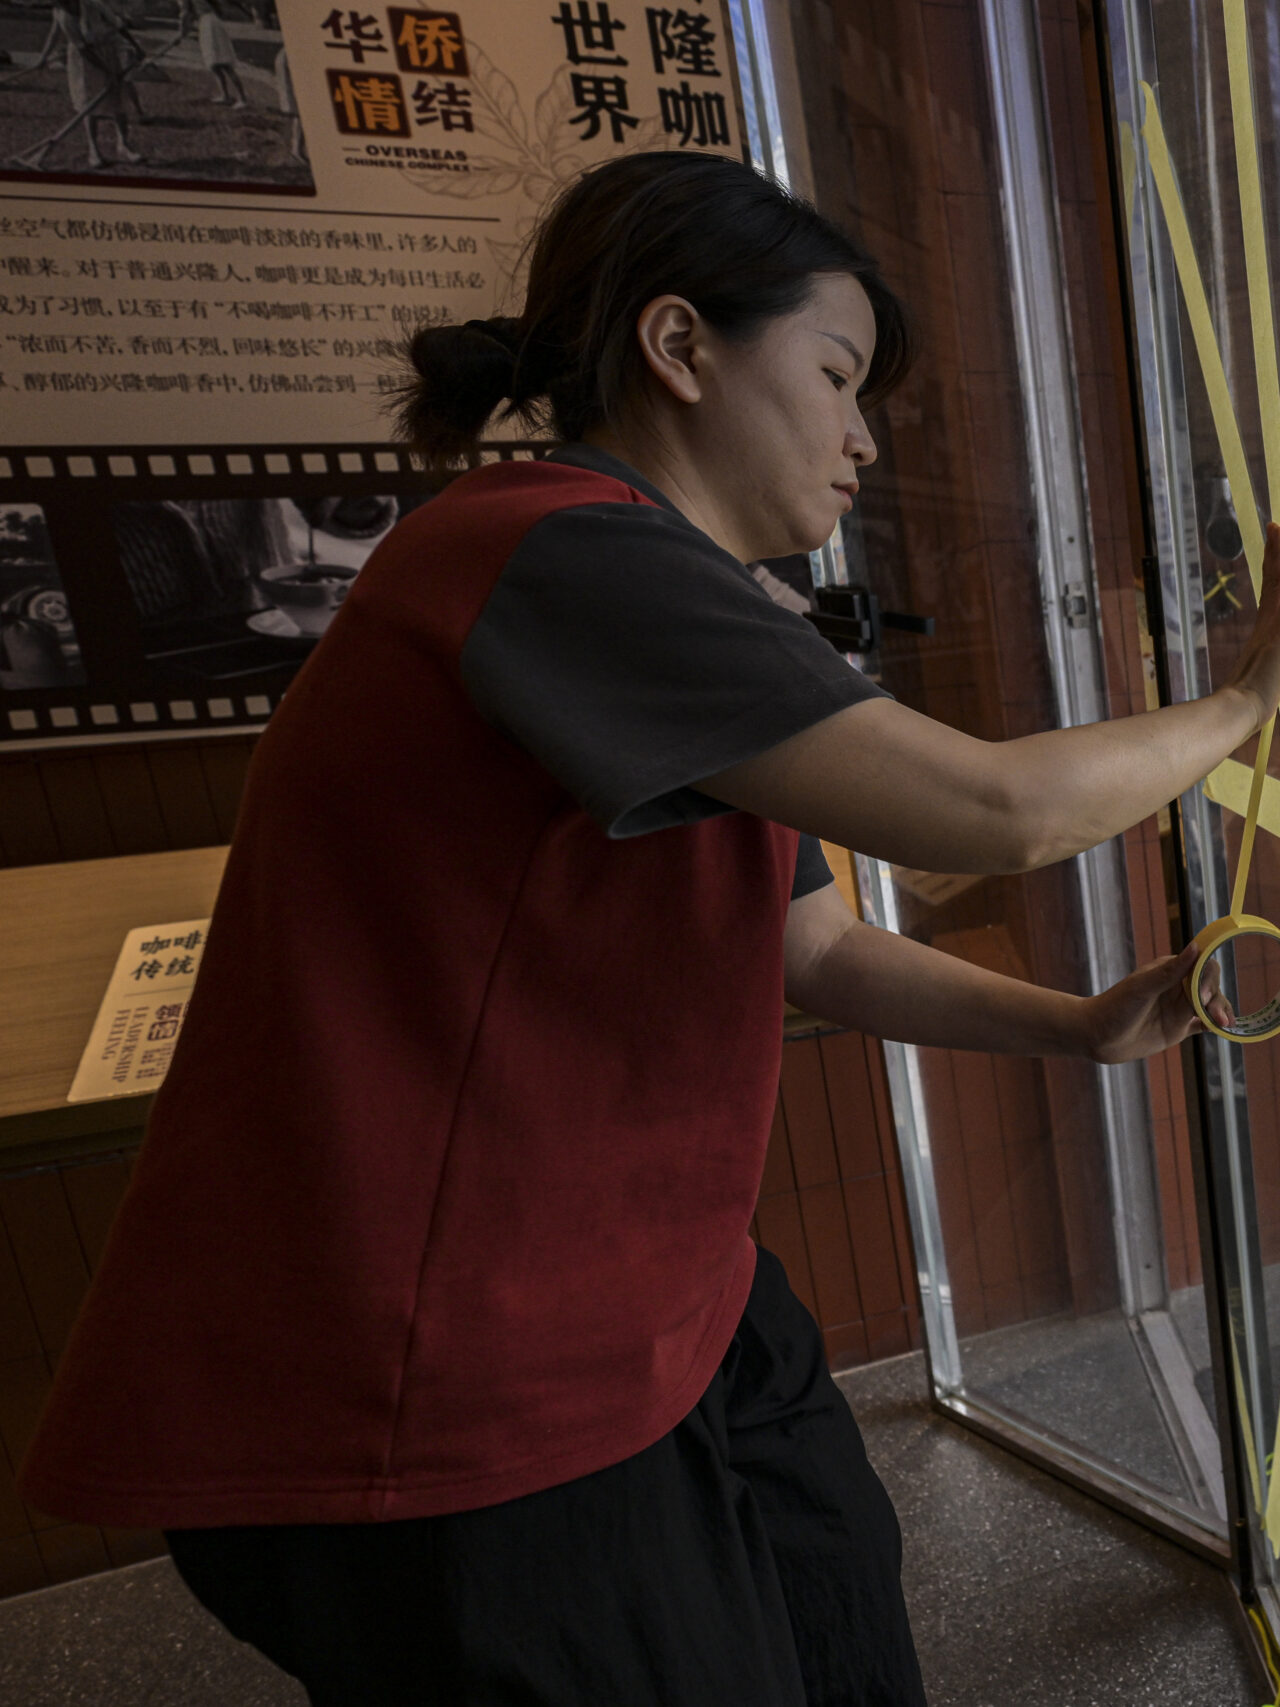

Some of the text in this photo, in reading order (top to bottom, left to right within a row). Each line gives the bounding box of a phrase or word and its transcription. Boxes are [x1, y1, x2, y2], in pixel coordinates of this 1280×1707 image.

[321, 9, 461, 69] 华侨
[552, 1, 639, 143] 世界
[645, 0, 731, 146] 隆咖
[335, 75, 475, 133] 情结
[345, 157, 470, 172] CHINESE COMPLEX
[366, 145, 468, 162] OVERSEAS
[0, 257, 485, 289] 醒来。对于普通兴隆人，咖啡更是成为每日生活必
[140, 930, 207, 955] 咖啡
[131, 956, 195, 981] 传统
